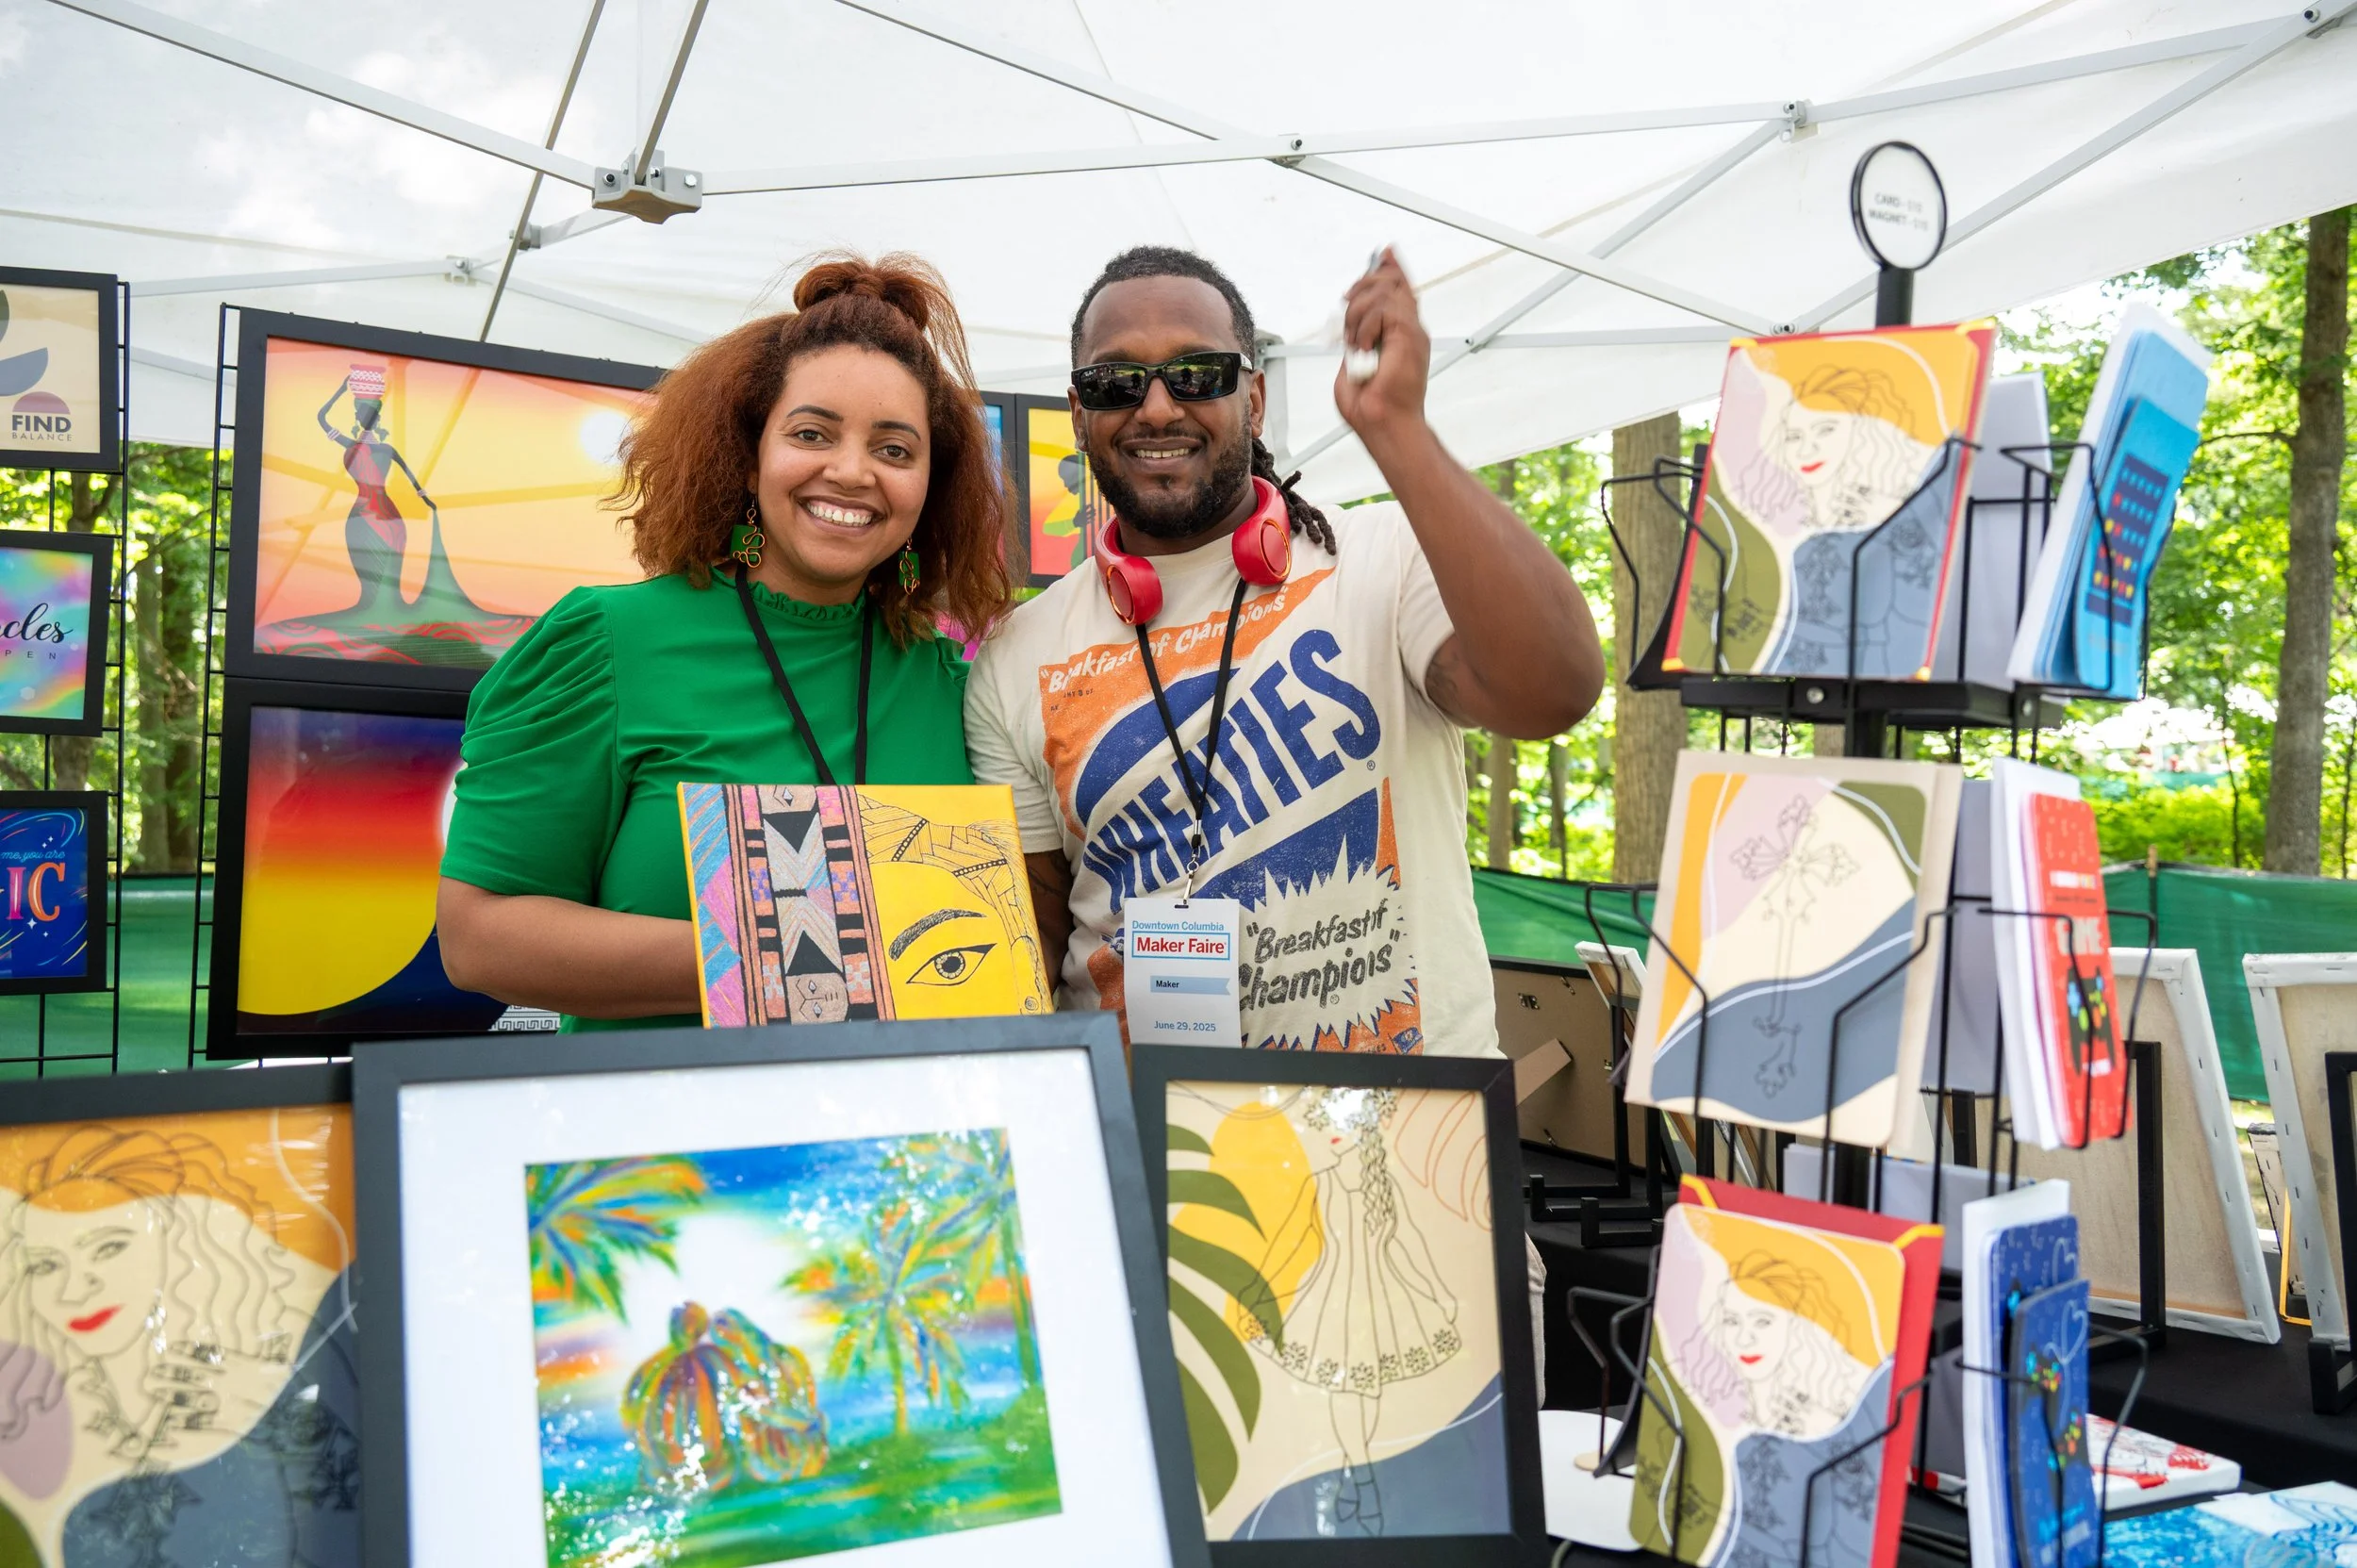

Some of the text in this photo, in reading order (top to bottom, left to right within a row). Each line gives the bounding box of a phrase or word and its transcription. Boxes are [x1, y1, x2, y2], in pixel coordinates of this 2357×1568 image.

[12, 415, 72, 433] FIND
[12, 433, 73, 441] BALANCE
[0, 602, 74, 643] cles
[1083, 629, 1381, 915] WHEATIES
[44, 850, 66, 859] are
[0, 862, 66, 922] IC
[1131, 920, 1225, 932] Downtown Columbia
[1136, 937, 1225, 954] Maker Faire
[1155, 980, 1179, 988] Maker
[1154, 1021, 1175, 1030] June
[1193, 1022, 1216, 1032] 2025
